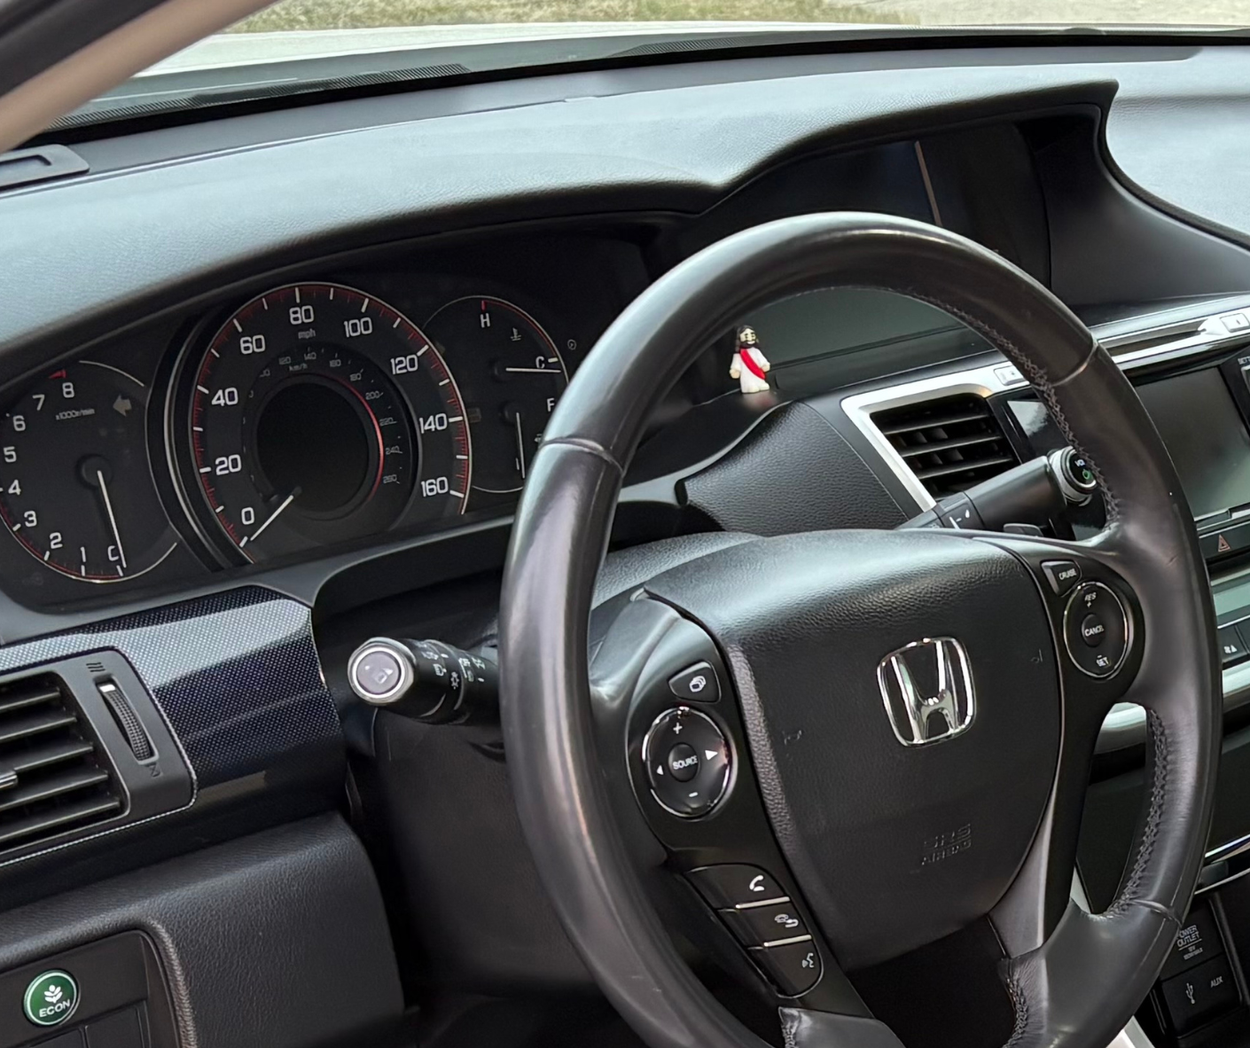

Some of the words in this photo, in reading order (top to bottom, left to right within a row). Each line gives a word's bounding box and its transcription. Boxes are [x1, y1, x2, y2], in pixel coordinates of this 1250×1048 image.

[289, 305, 314, 324] 80
[480, 313, 491, 328] H
[298, 328, 316, 339] mph
[343, 317, 373, 337] 100
[239, 334, 266, 355] 60
[390, 354, 419, 375] 120
[62, 382, 75, 398] 8
[211, 387, 239, 407] 40
[32, 394, 45, 411] 7
[546, 398, 555, 412] F
[12, 415, 26, 432] 6
[418, 413, 448, 434] 140
[3, 446, 17, 463] 5
[215, 454, 242, 475] 20
[8, 479, 21, 495] 4
[420, 476, 449, 498] 160
[24, 510, 38, 527] 3
[241, 507, 255, 525] 0
[49, 532, 63, 549] 2
[80, 546, 87, 563] 1
[672, 754, 698, 770] SOURCE
[39, 999, 71, 1018] ECON
